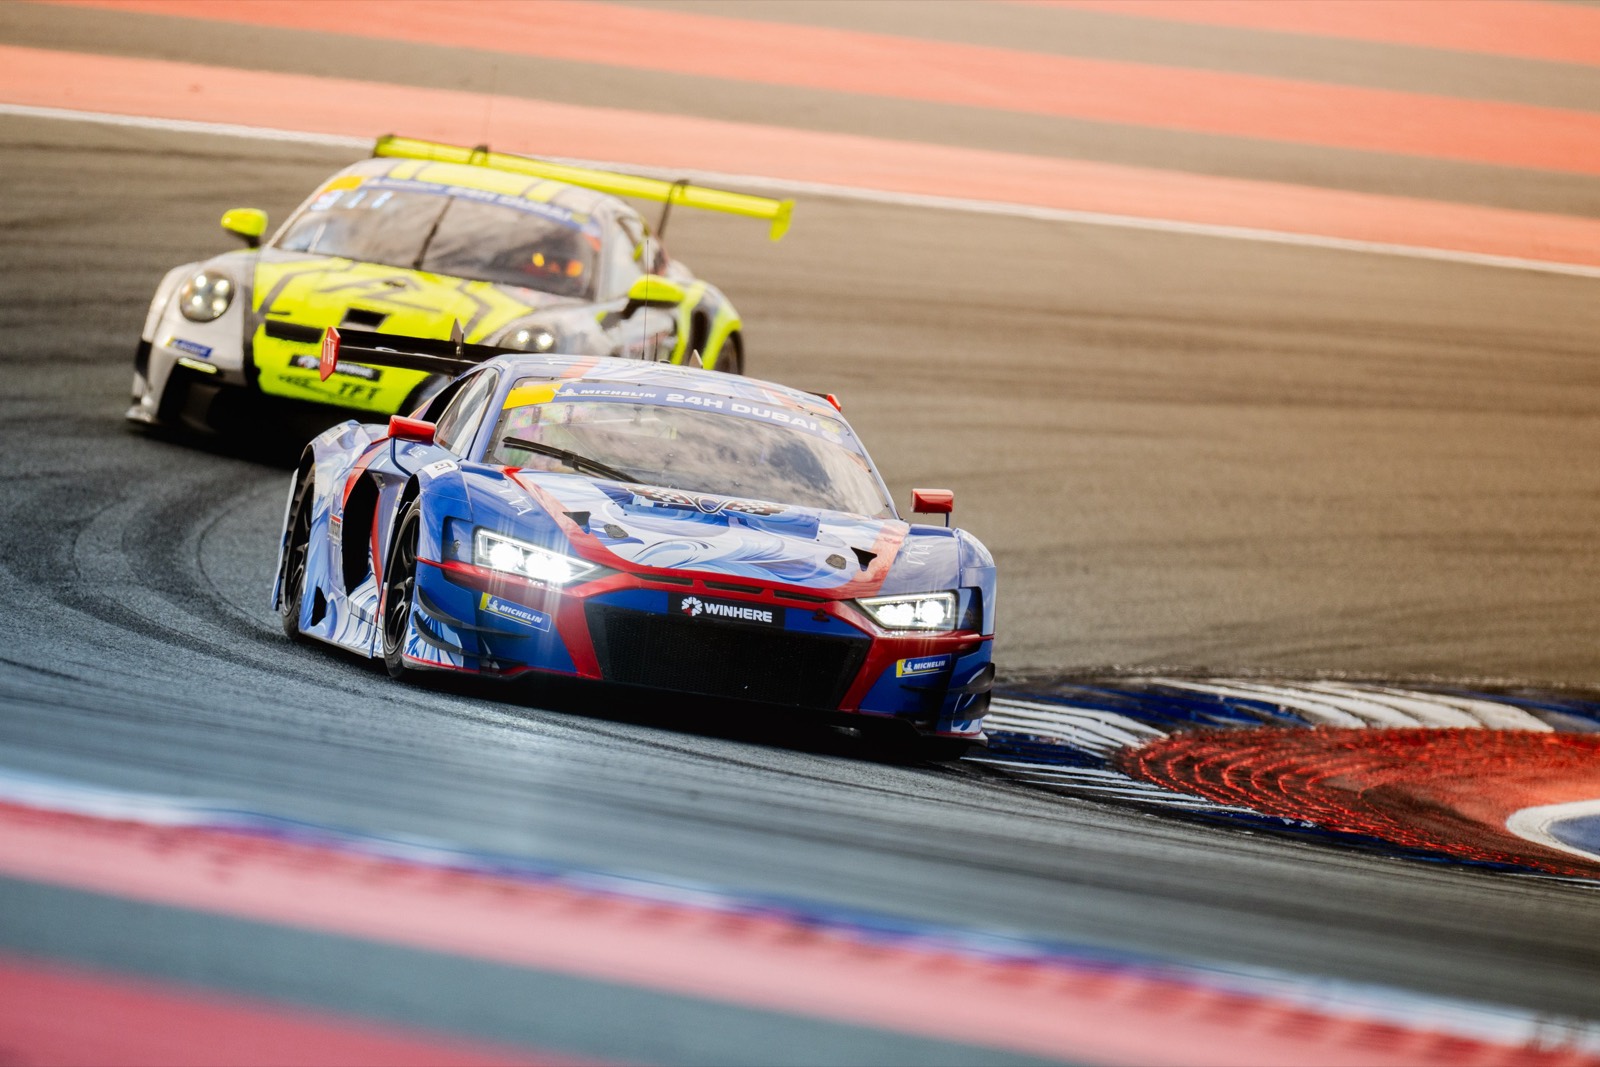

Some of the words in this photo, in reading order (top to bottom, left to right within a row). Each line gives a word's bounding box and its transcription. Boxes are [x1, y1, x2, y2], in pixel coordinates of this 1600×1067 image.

[580, 389, 657, 398] MICHELIN
[665, 392, 723, 410] 24H
[731, 404, 817, 431] DUBAI
[499, 604, 543, 624] MICHELIN
[704, 602, 773, 623] WINHERE
[913, 660, 946, 670] MICHELIN
